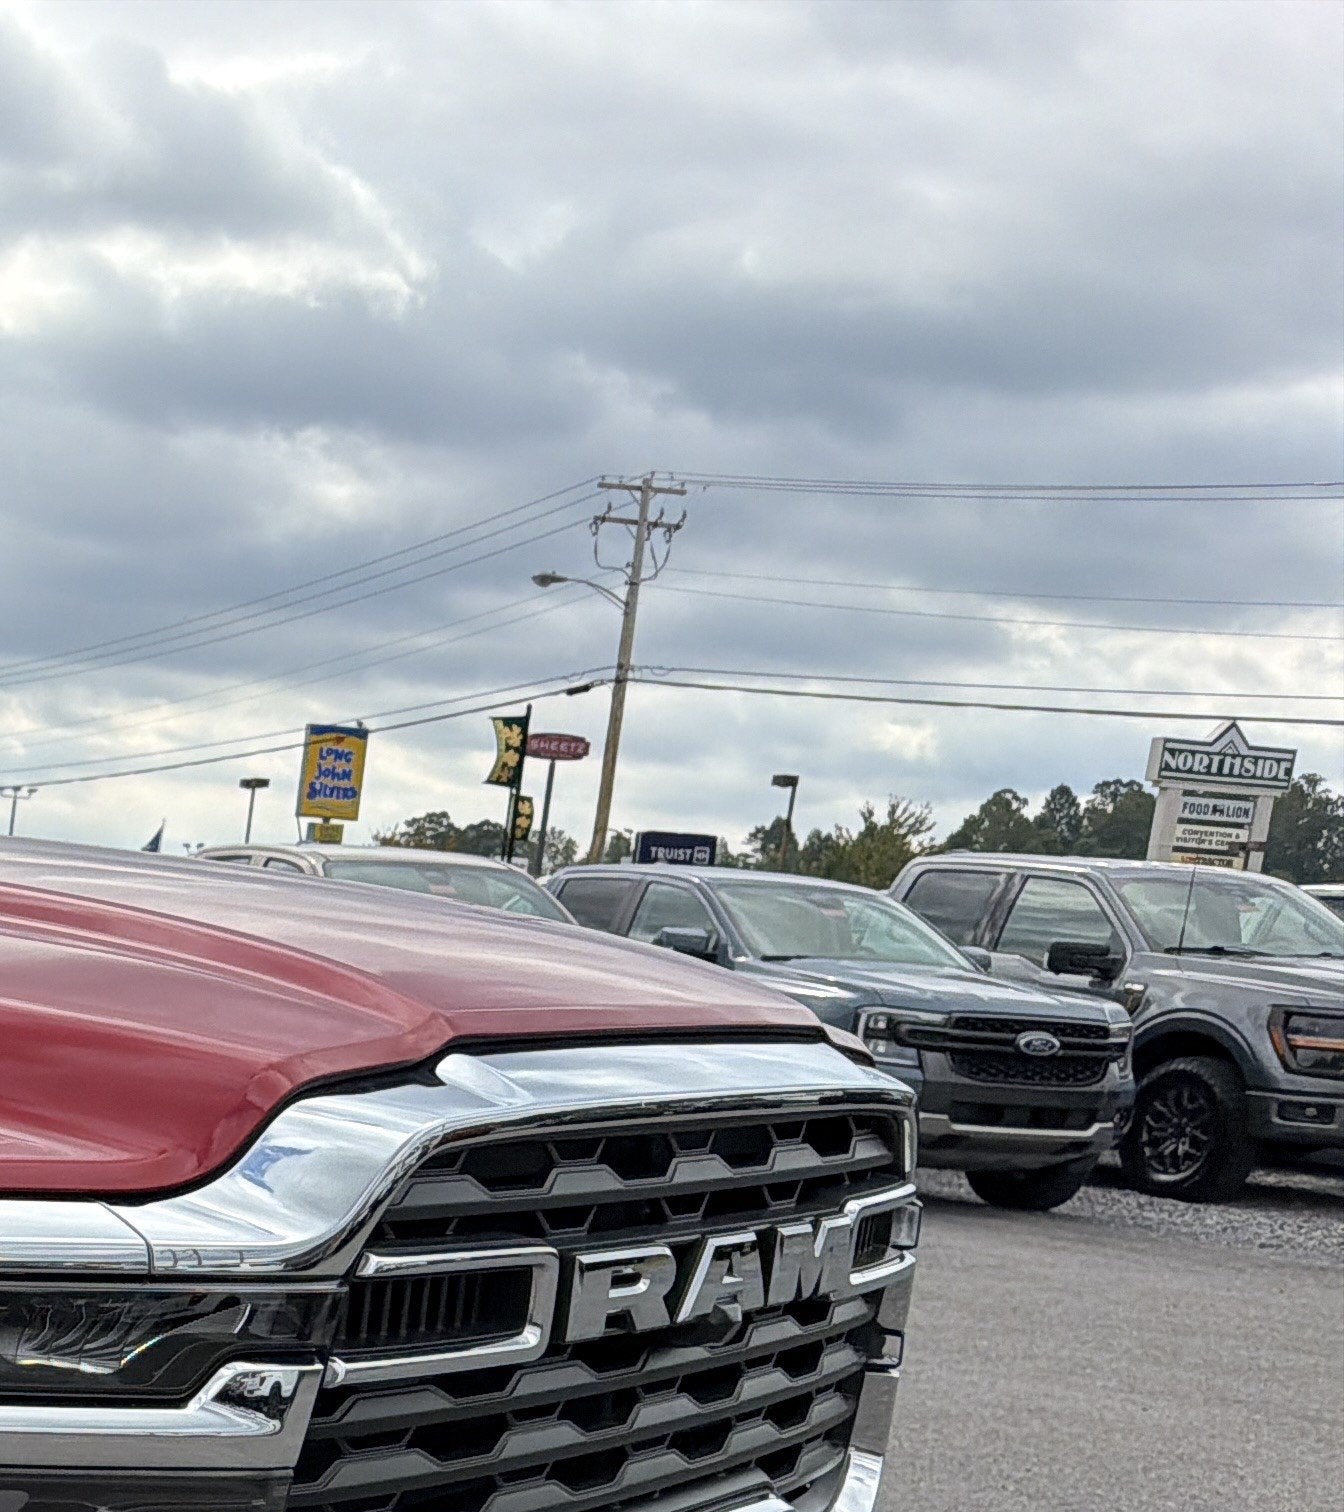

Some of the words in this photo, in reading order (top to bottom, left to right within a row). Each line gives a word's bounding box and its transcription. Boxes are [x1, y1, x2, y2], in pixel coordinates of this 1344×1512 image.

[1161, 750, 1291, 780] NORTHSIDE
[1182, 801, 1211, 816] FOOD
[1226, 803, 1251, 819] LION
[650, 846, 692, 861] TRUIST
[563, 1215, 854, 1343] RAM
